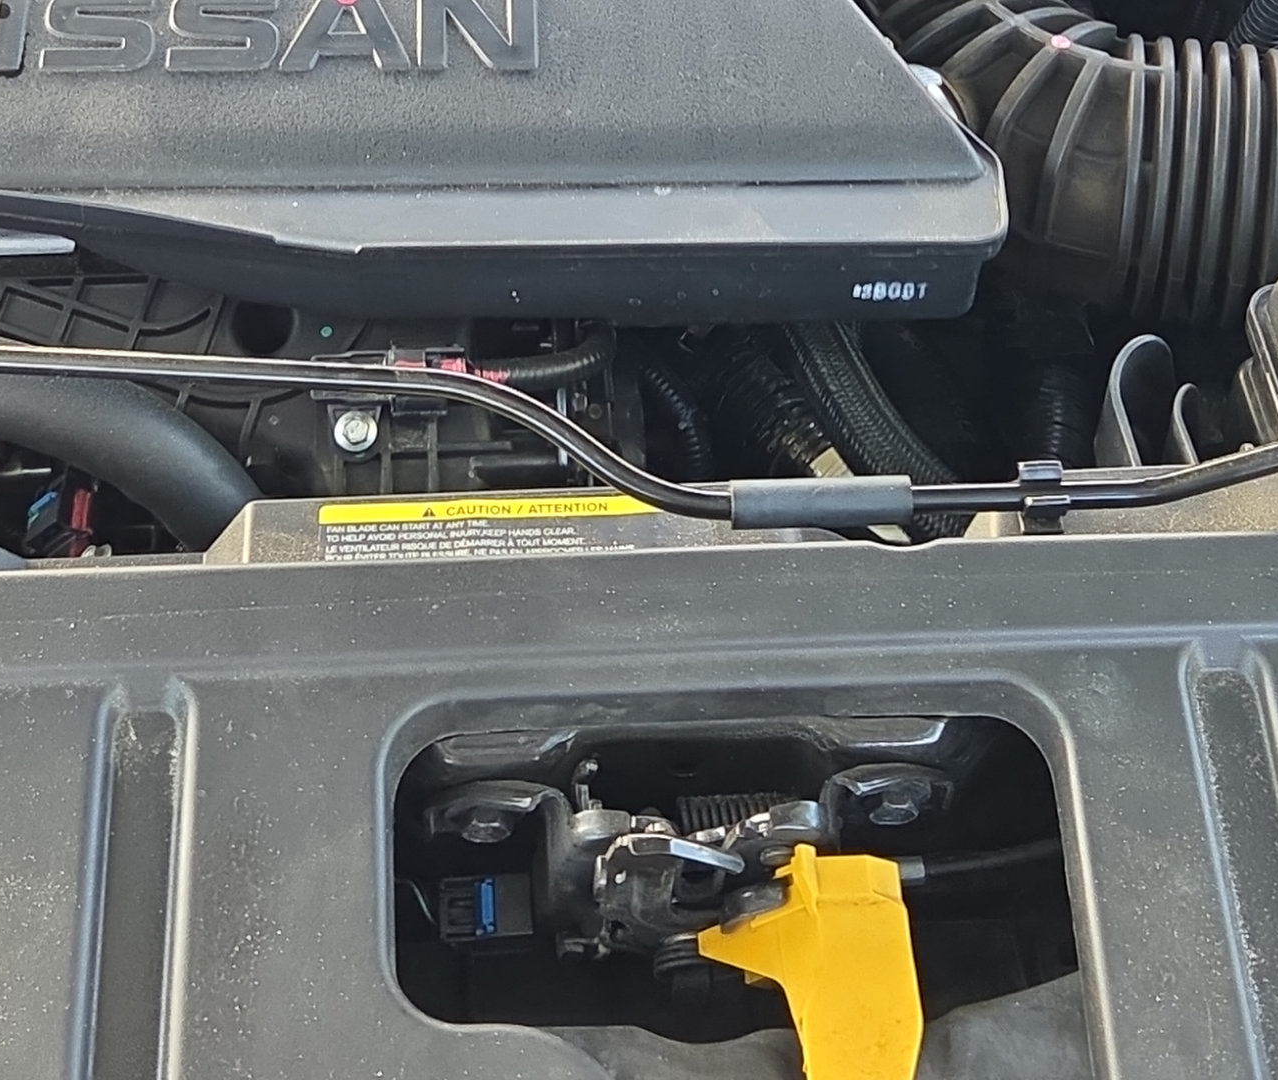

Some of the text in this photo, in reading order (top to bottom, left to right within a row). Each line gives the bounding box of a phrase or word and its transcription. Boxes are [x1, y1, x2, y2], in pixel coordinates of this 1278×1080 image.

[446, 504, 511, 517] CAUTION
[528, 502, 608, 514] ATTENTION
[326, 525, 345, 534] FAN
[347, 524, 378, 533] BLADE
[379, 523, 400, 532] CAN
[402, 522, 431, 531] START
[433, 521, 444, 530] AT
[445, 521, 465, 530] ANY
[327, 534, 339, 543] TO
[341, 533, 366, 543] HELP
[367, 532, 397, 542] AVOID
[398, 531, 448, 541] PERSONAL
[509, 528, 542, 537] HANDS
[326, 545, 338, 554] LE
[339, 543, 400, 553] VENTILATEUR
[402, 542, 437, 551] RISQUE
[439, 541, 452, 550] DE
[454, 537, 506, 550] DÉMARRER
[516, 538, 542, 548] TOUT
